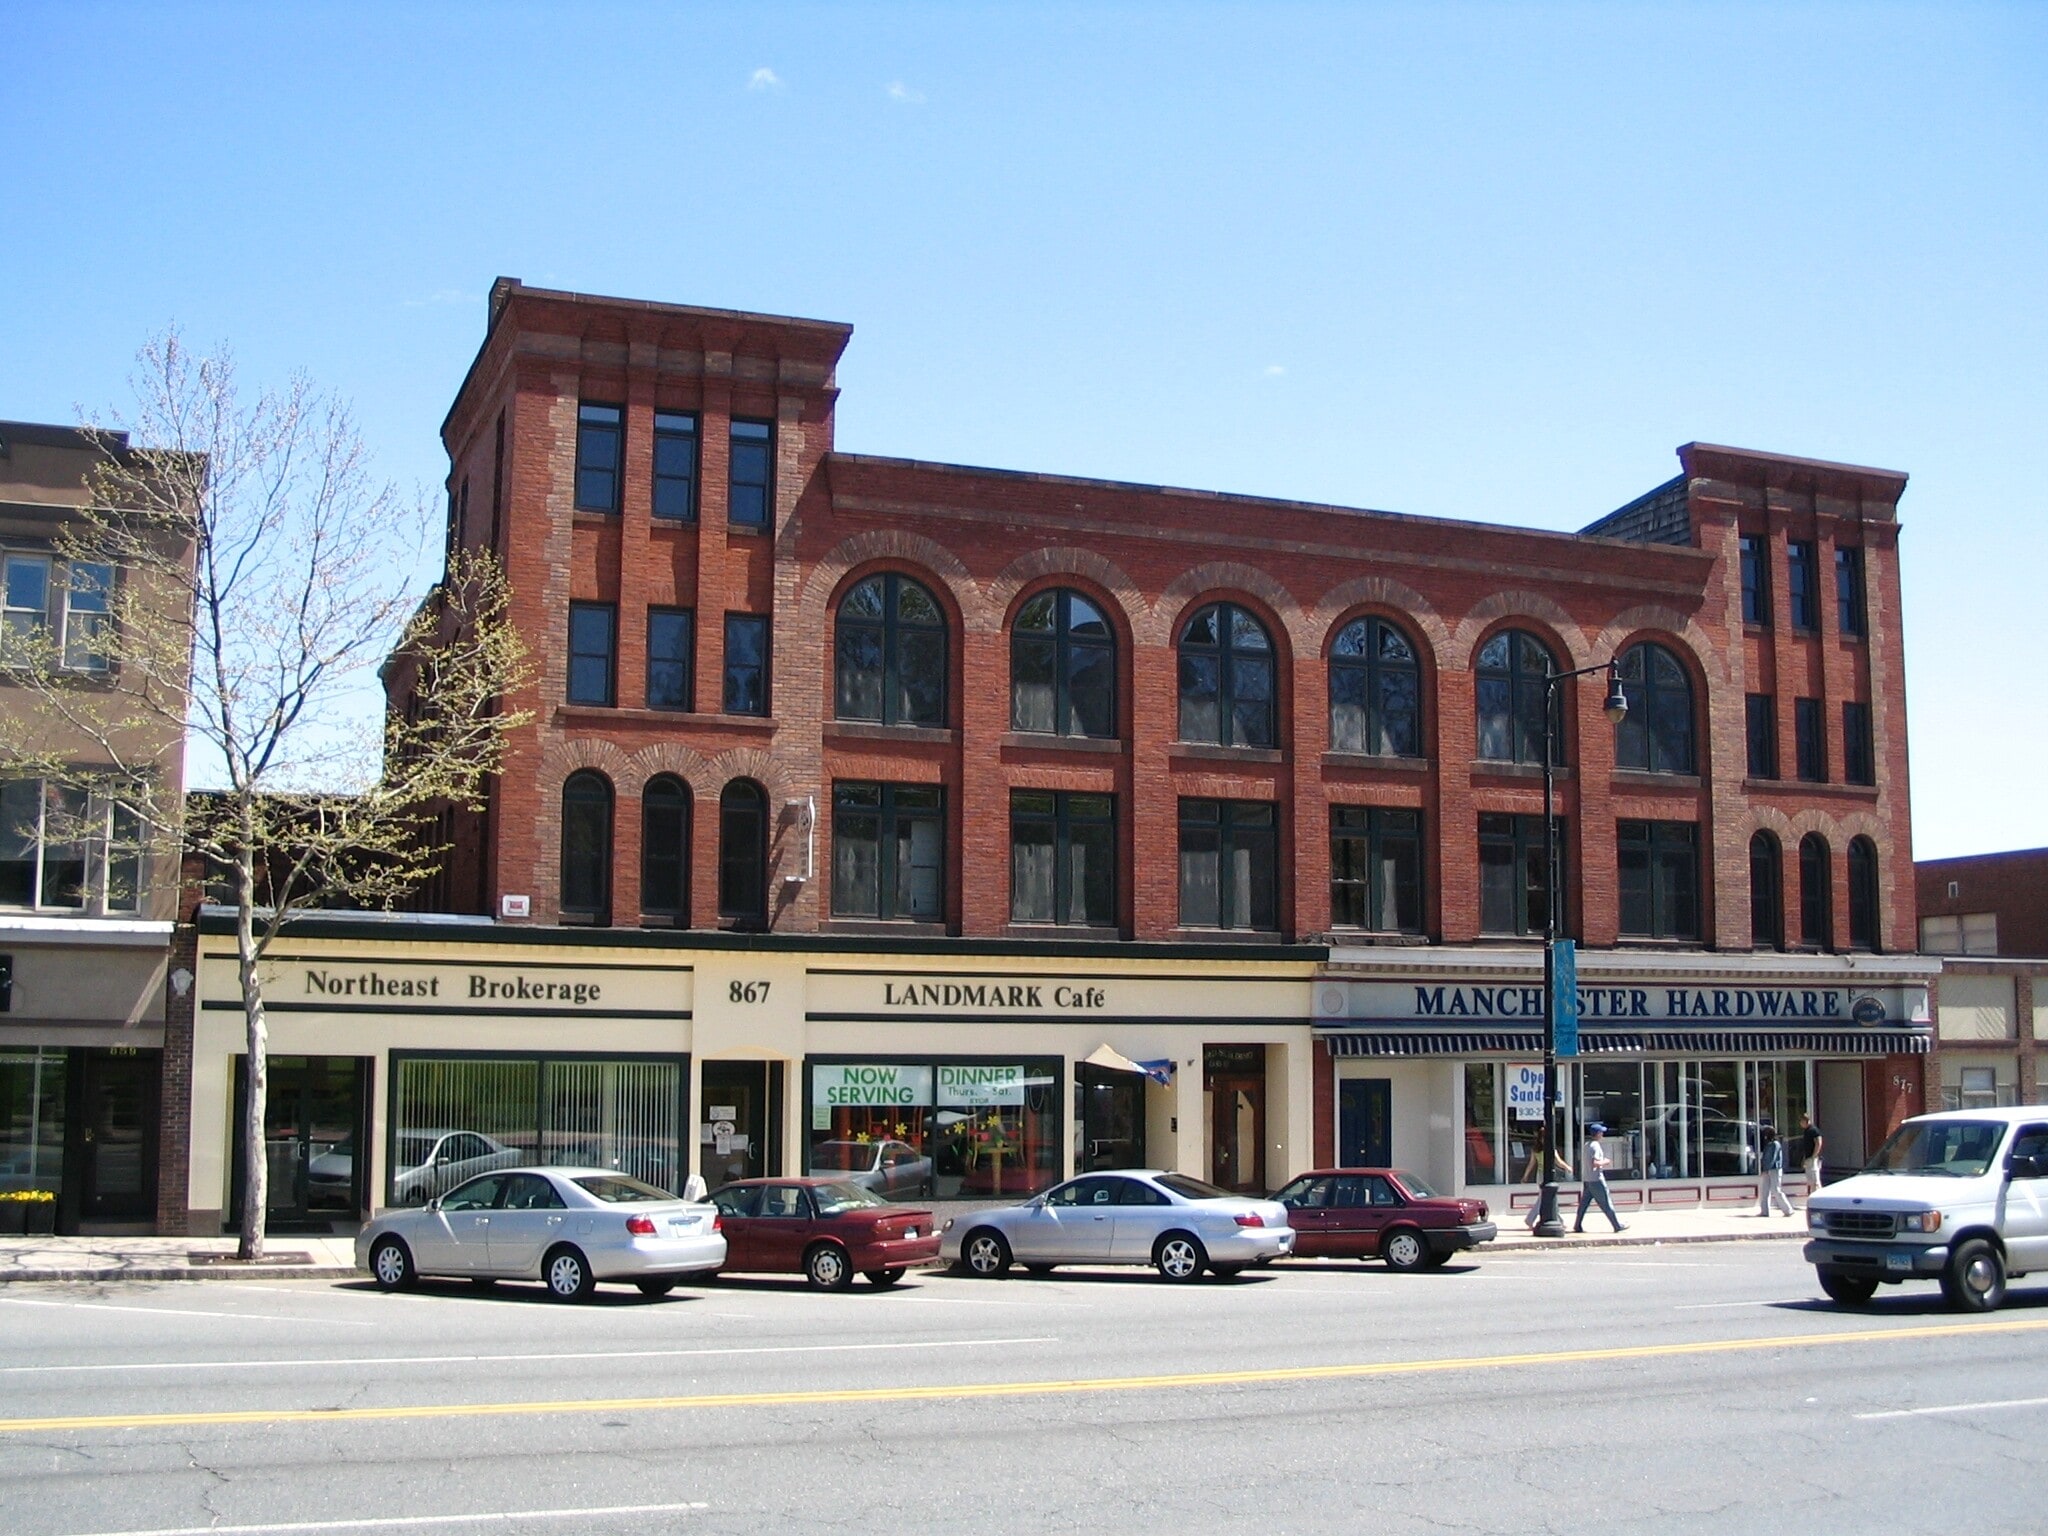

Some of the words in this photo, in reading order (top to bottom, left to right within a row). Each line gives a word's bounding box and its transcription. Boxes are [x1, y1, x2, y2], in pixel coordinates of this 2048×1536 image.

[305, 971, 440, 996] Northeast
[468, 975, 601, 1004] Brokerage
[729, 981, 770, 1004] 867
[884, 983, 1042, 1007] LANDMARK
[1054, 986, 1106, 1008] Café
[1415, 987, 1650, 1016] MANCHSTER
[1666, 990, 1840, 1016] HARDWARE
[844, 1068, 898, 1085] NOW
[940, 1068, 1016, 1085] DINNER
[1521, 1068, 1546, 1088] Ope
[1893, 1074, 1913, 1093] 877
[828, 1086, 913, 1104] SERVING
